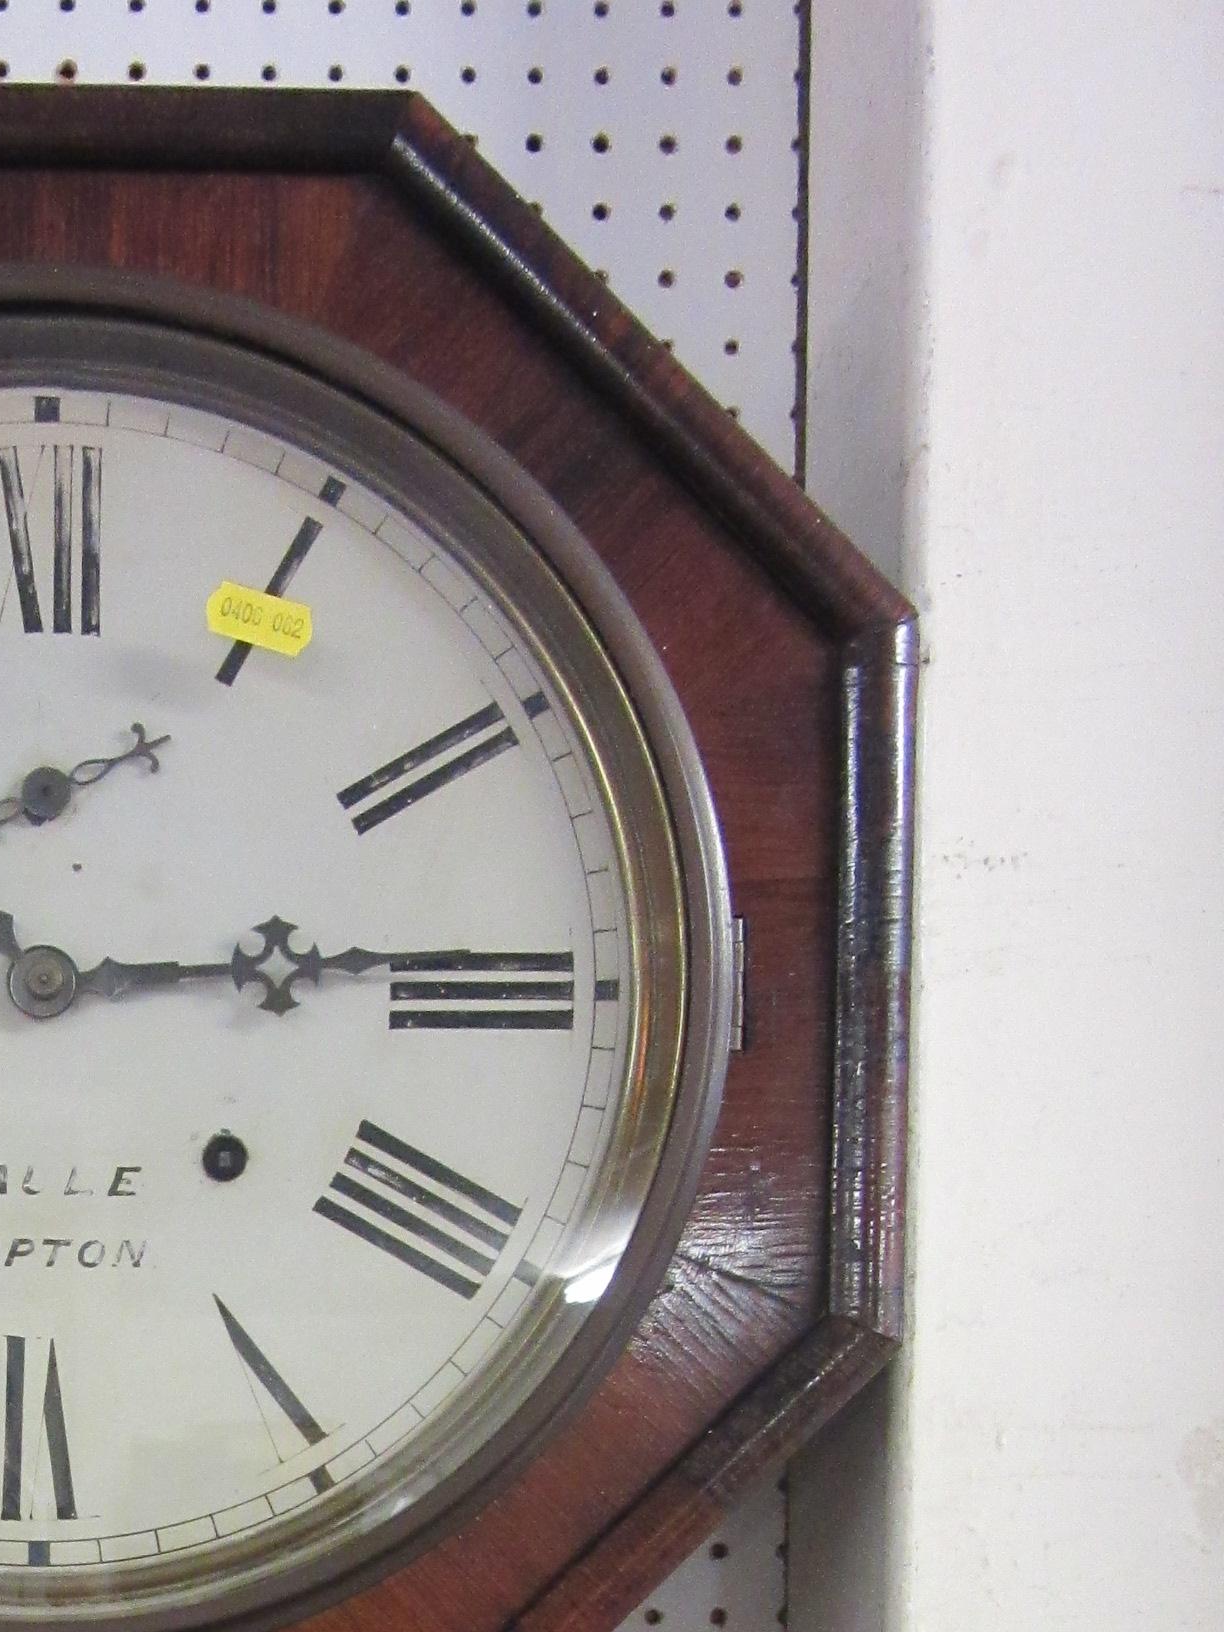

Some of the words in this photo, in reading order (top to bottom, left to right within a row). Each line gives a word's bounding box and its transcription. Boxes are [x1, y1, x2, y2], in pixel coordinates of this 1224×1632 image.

[336, 700, 520, 836] II
[389, 951, 574, 1030] III
[312, 1119, 526, 1300] IIII
[1, 1335, 79, 1520] VI
[212, 1293, 332, 1464] V
